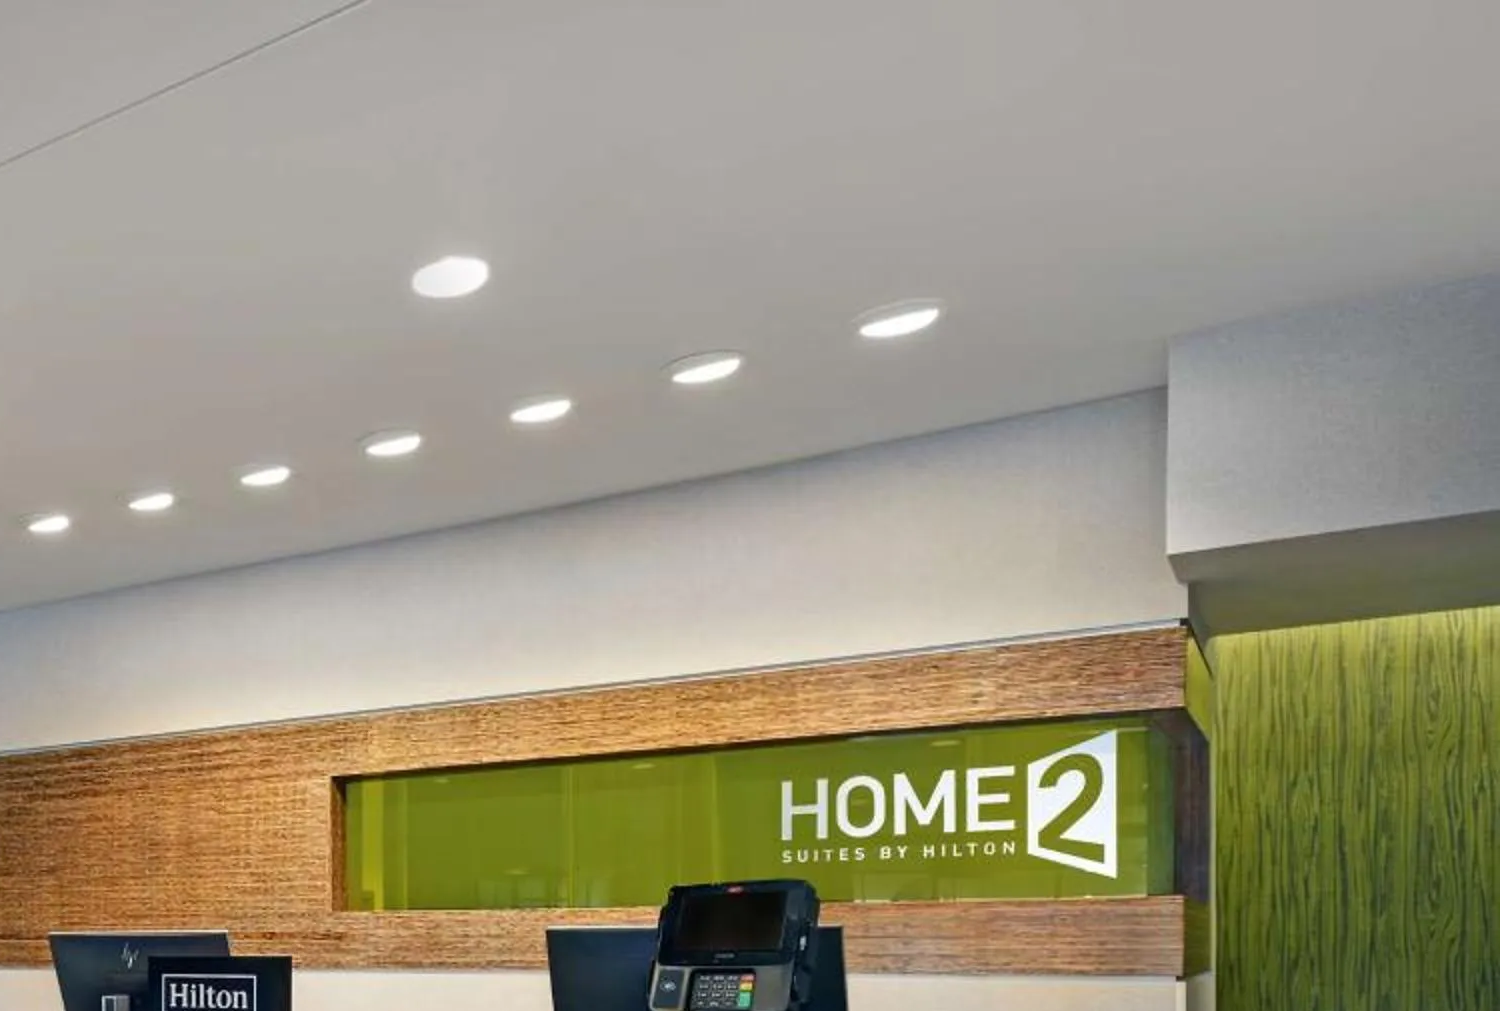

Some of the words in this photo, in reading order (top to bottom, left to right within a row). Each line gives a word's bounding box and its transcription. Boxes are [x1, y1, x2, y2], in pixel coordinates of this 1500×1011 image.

[781, 847, 866, 863] SUITES
[880, 845, 907, 859] BY
[923, 841, 1016, 858] HILTON
[169, 983, 248, 1009] Hilton
